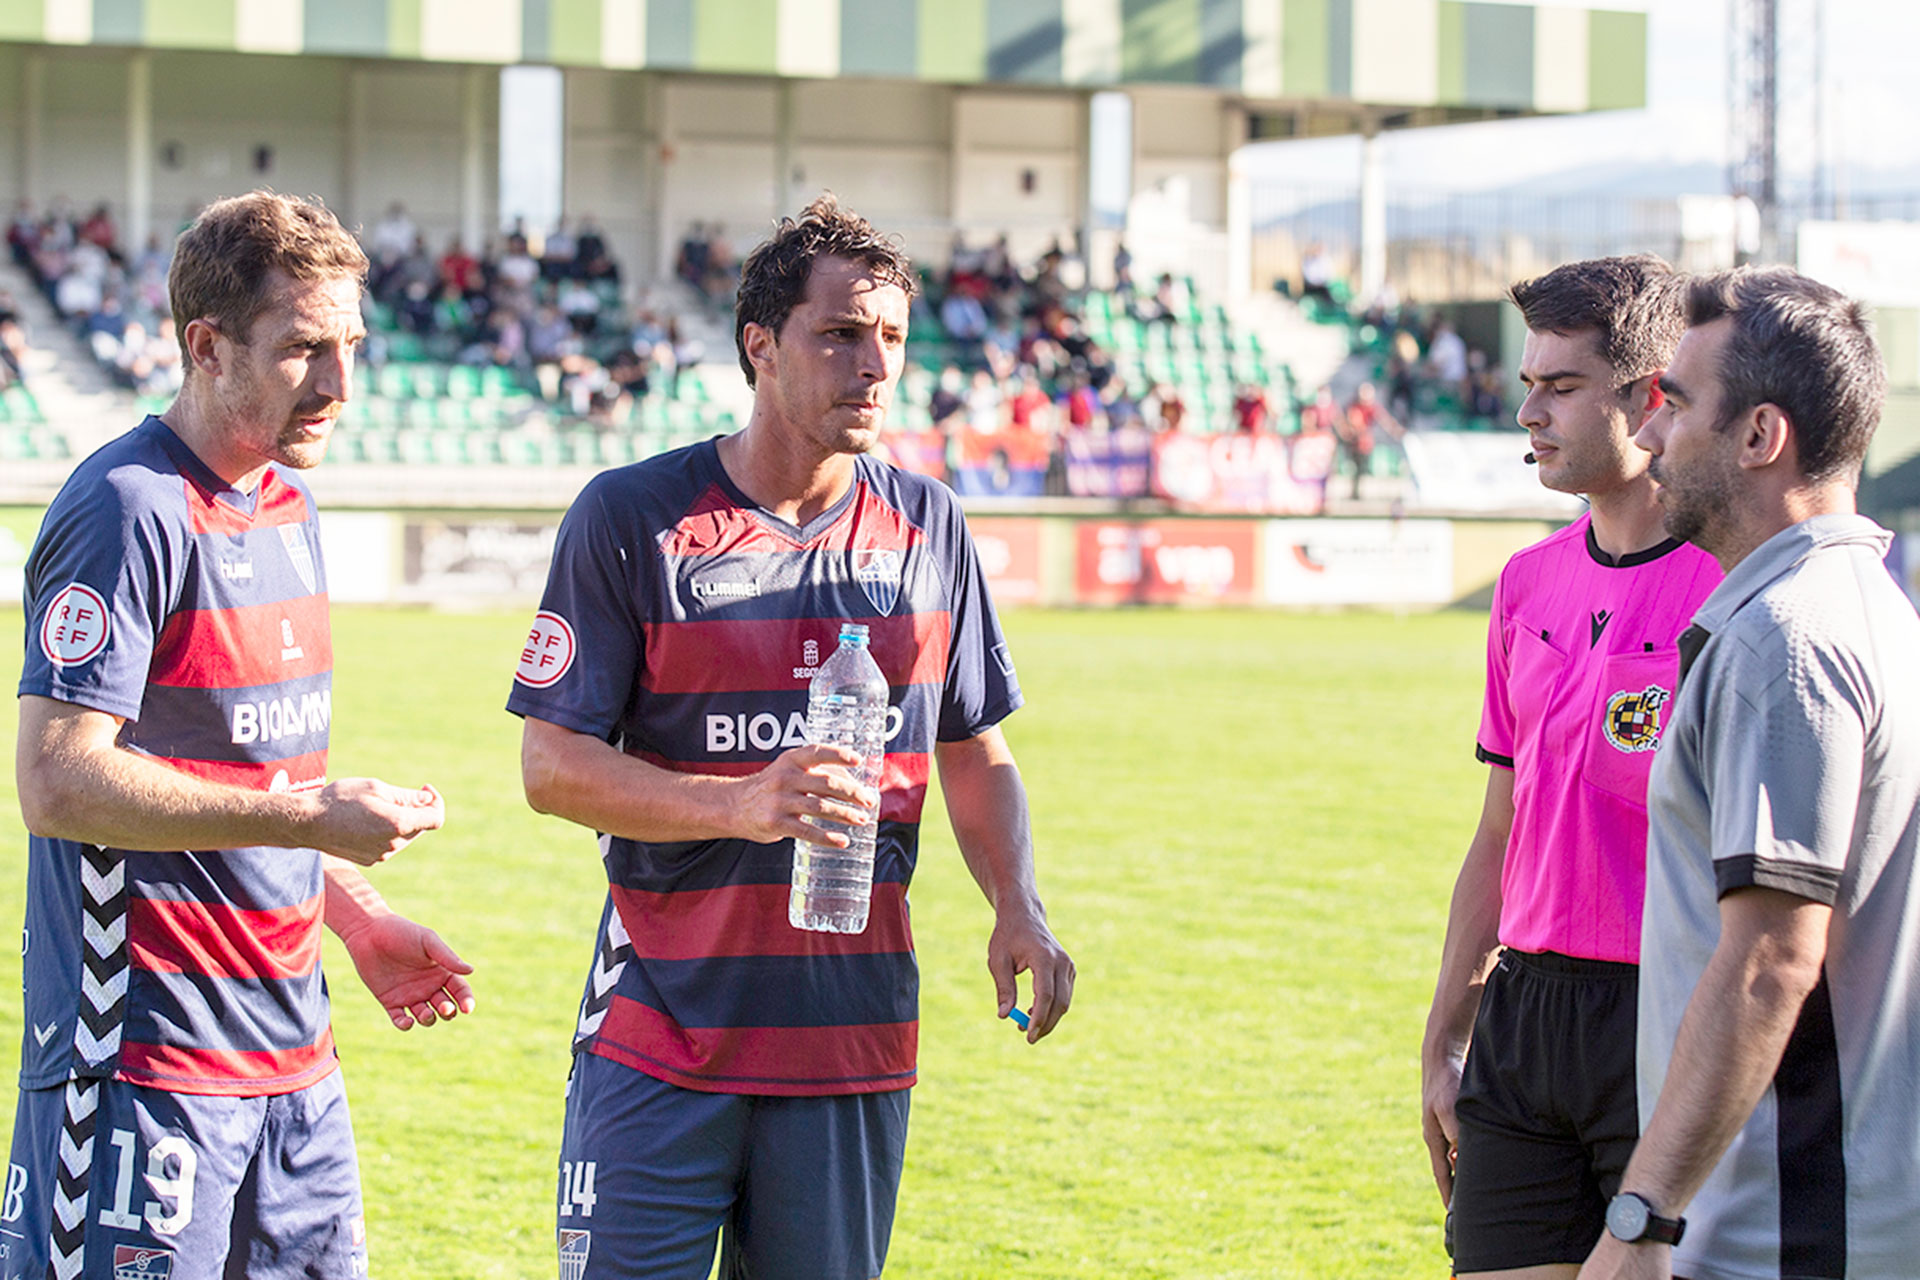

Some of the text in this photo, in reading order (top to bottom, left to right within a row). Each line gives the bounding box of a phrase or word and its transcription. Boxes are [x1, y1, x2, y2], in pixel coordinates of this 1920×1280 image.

[690, 577, 762, 602] hummel
[792, 667, 820, 679] SEGO
[706, 704, 904, 752] BIOAO
[98, 1127, 198, 1237] 19
[560, 1161, 597, 1218] 14
